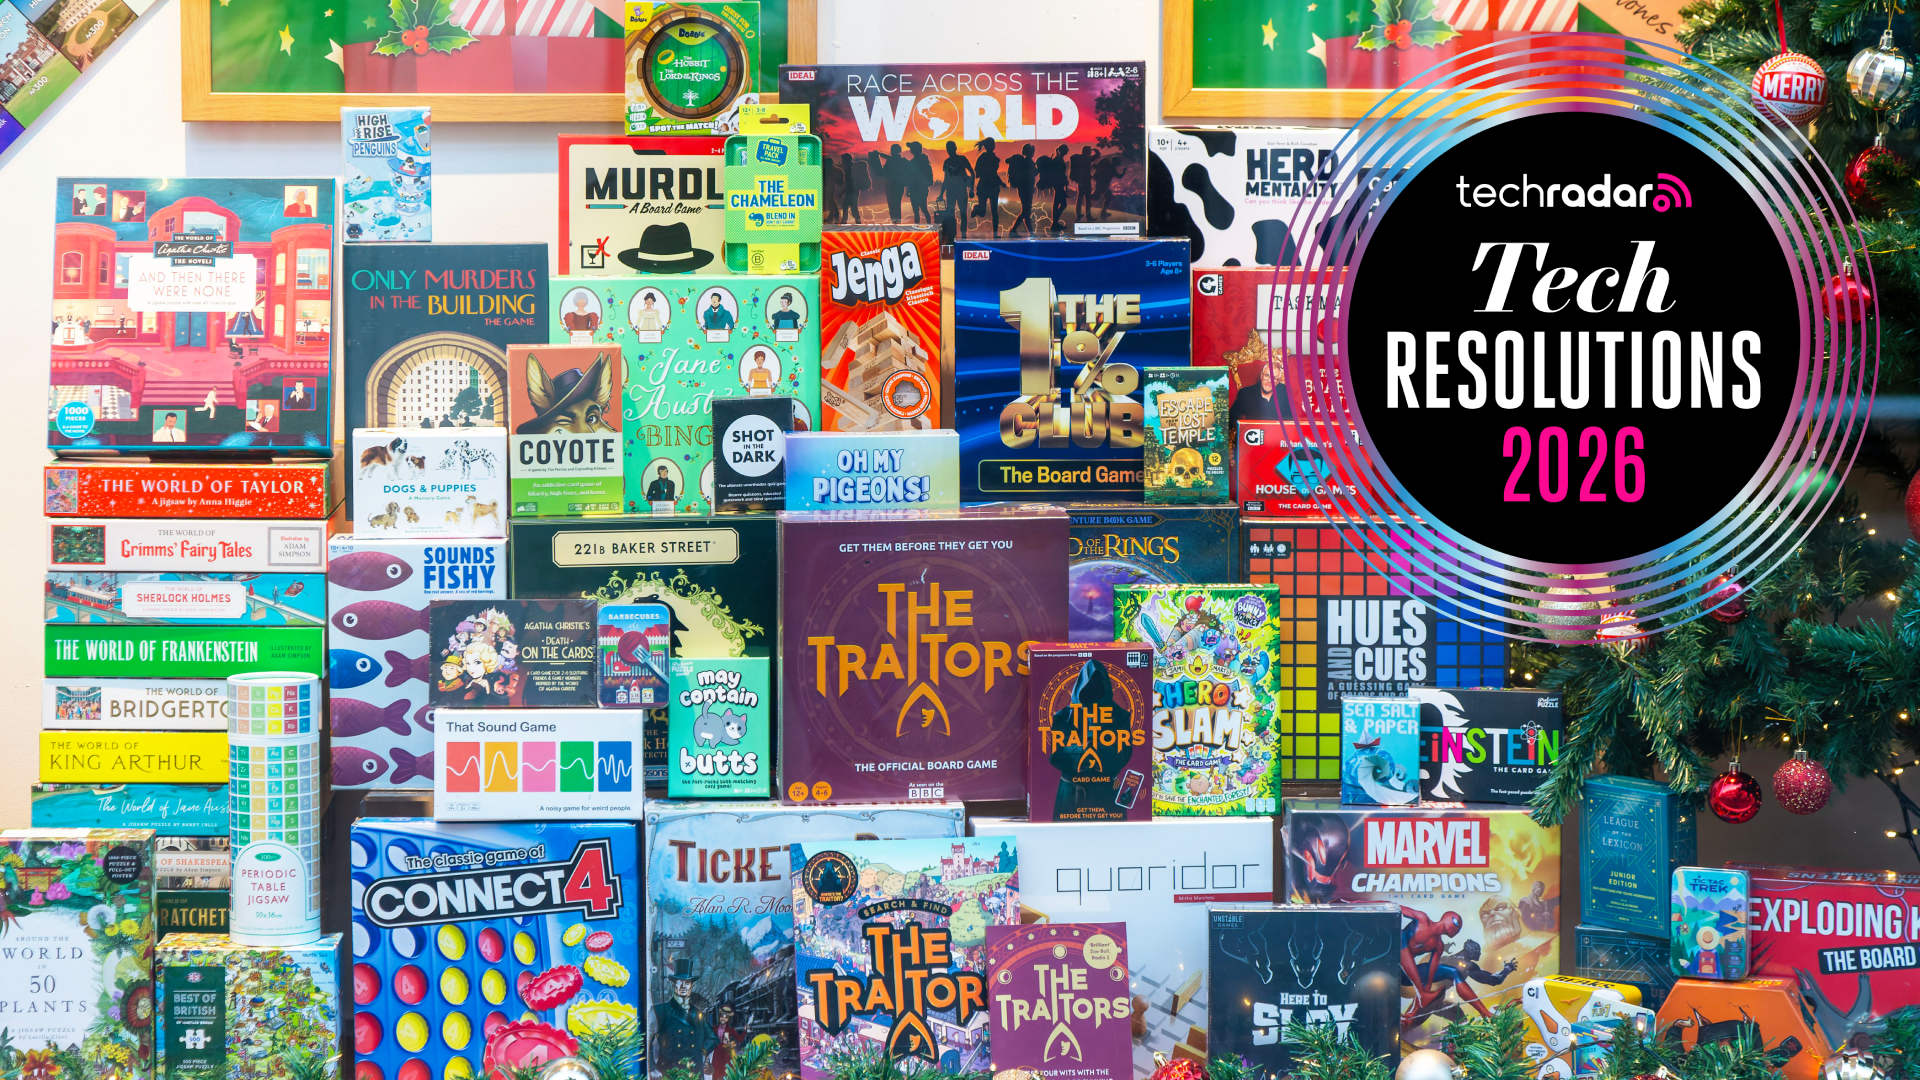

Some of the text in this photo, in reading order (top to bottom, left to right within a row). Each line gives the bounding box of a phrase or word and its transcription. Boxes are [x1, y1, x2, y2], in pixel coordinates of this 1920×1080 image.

[789, 71, 814, 80] IDEAL
[847, 71, 1080, 93] RACE ACROSS THE
[1763, 73, 1825, 102] MERRY
[357, 114, 388, 126] HIGH
[649, 124, 672, 133] SPOT
[685, 120, 719, 131] MATCH!
[848, 93, 1080, 142] WORLD
[363, 125, 393, 139] RISE
[353, 142, 397, 155] PENGUINS
[1246, 148, 1339, 182] HERD
[758, 180, 785, 194] THE
[1245, 181, 1338, 198] MENTALITY
[731, 193, 815, 208] CHAMELEON
[766, 212, 796, 220] BLEND IN
[157, 243, 229, 256] Agatha Christie
[831, 241, 923, 302] Jenga
[1158, 260, 1183, 269] Players
[139, 271, 246, 283] AND THEN THERE
[351, 268, 537, 291] ONLY MURDERS
[153, 285, 231, 297] WERE NONE
[370, 294, 535, 315] IN THE BUILDING
[1058, 294, 1141, 324] THE
[1160, 397, 1213, 418] ESCAPE
[1000, 401, 1144, 449] CLUB
[1178, 413, 1208, 430] LOST
[732, 429, 775, 443] SHOT
[1158, 426, 1216, 447] TEMPLE
[519, 438, 615, 466] COYOTE
[732, 450, 776, 463] DARK
[837, 449, 904, 473] OH MY
[1000, 466, 1144, 484] The Board Game
[102, 479, 304, 494] THE WORLD OF TAYLOR
[383, 483, 477, 493] DOGS & PUPPIES
[812, 476, 931, 504] PIGEONS!
[1255, 485, 1297, 495] HOUSE
[160, 497, 185, 507] jigsaw
[187, 498, 197, 507] by
[199, 498, 222, 506] Anna
[224, 497, 252, 508] Higgie
[121, 539, 253, 562] Grimms' Fairy Tales
[423, 546, 495, 564] SOUNDS
[612, 542, 656, 554] BAKER
[660, 541, 711, 553] STREET
[839, 540, 1013, 553] GET THEM BEFORE THEY GET YOU
[1103, 533, 1180, 564] RINGS
[423, 565, 496, 590] FISHY
[136, 592, 231, 604] SHERLOCK HOLMES
[878, 582, 974, 645] THE
[1327, 599, 1428, 646] HUES
[524, 621, 591, 630] AGATHA CHRISTIE'S
[546, 637, 570, 645] DEATH
[54, 640, 258, 663] THE WORLD OF FRANKENSTEIN
[522, 646, 594, 659] ON THE CARDS
[808, 634, 1040, 698] TRAITORS
[1327, 647, 1352, 681] AND
[1354, 646, 1428, 682] CUES
[697, 669, 742, 689] may
[679, 685, 758, 708] contain
[1164, 680, 1231, 707] HERO
[1070, 703, 1113, 731] THE
[1344, 703, 1419, 718] SEA SALT
[446, 721, 557, 732] That Sound Game
[1153, 706, 1243, 750] SLAM
[1344, 719, 1419, 735] & PAPER
[1038, 726, 1145, 755] TRAITORS
[50, 754, 205, 773] KING ARTHUR
[679, 747, 758, 775] butts
[1603, 815, 1640, 829] LEAGUE
[1367, 820, 1488, 866] MARVEL
[1602, 836, 1643, 851] LEXICON
[241, 869, 297, 879] PERIODIC
[370, 846, 613, 921] CONNECT 4
[1056, 851, 1260, 906] quoridor
[1351, 872, 1502, 894] CHAMPIONS
[250, 882, 286, 892] TABLE
[1689, 883, 1728, 893] TREK
[247, 895, 290, 905] JIGSAW
[1749, 897, 1903, 940] EXPLODING
[3, 947, 83, 960] WORLD
[1823, 945, 1917, 972] THE BOARD
[29, 974, 56, 994] 50
[1034, 963, 1088, 998] THE
[0, 1000, 87, 1013] PLANTS
[996, 992, 1130, 1032] TRAITORS
